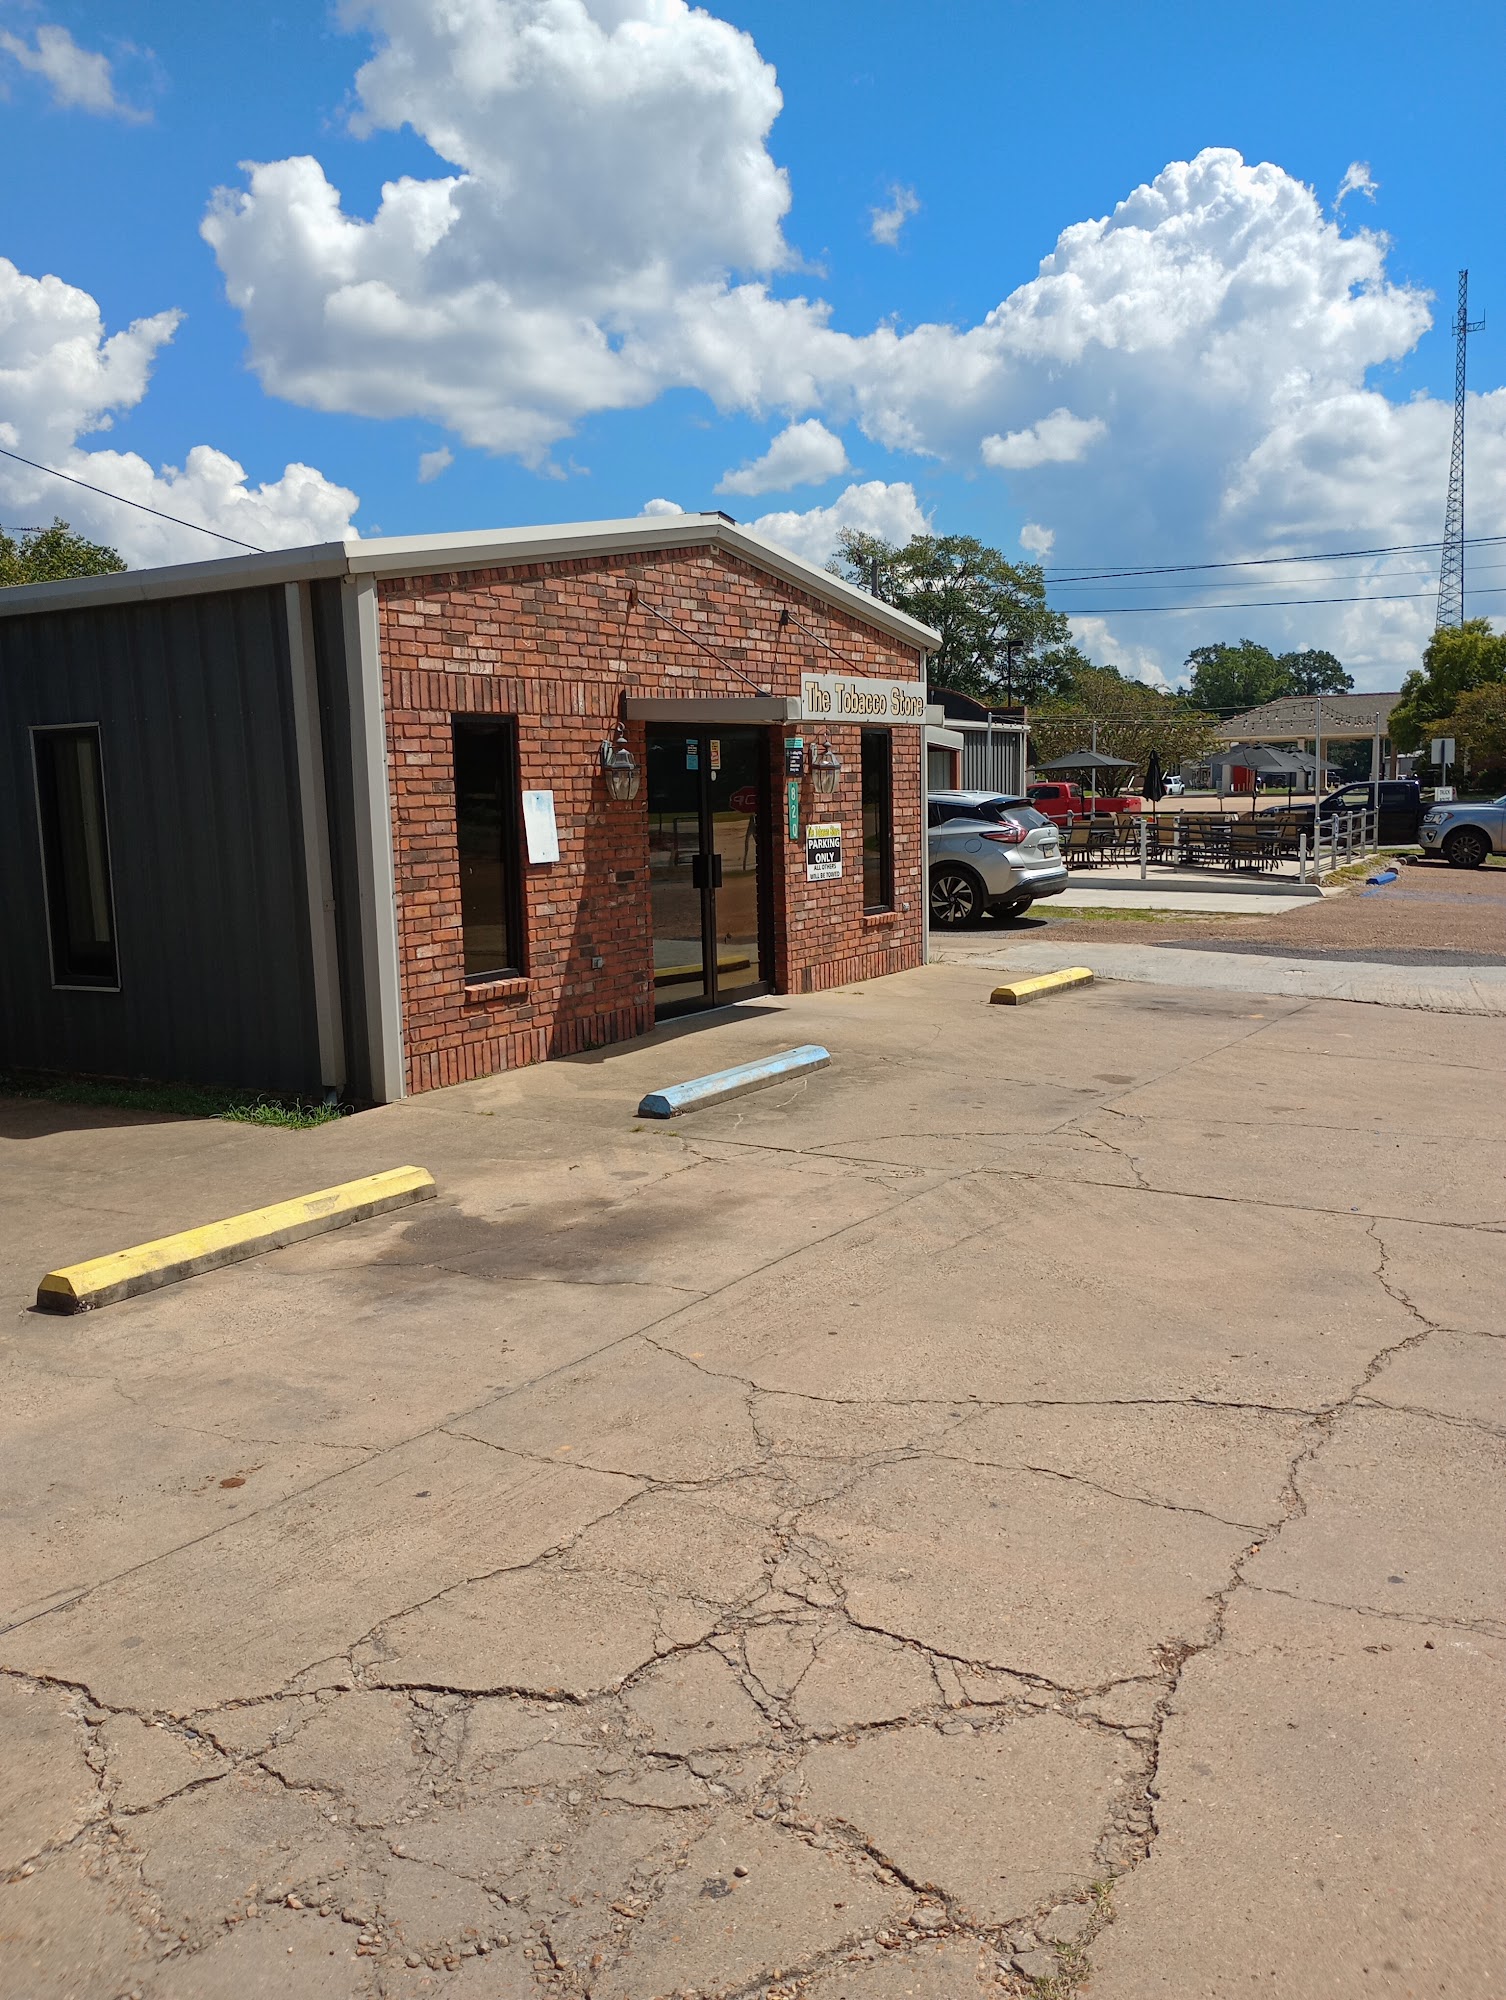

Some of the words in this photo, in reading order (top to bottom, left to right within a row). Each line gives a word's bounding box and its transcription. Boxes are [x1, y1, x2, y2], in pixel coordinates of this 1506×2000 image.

[805, 681, 831, 713] The
[835, 683, 887, 715] Tobacco
[890, 686, 924, 717] Store
[790, 787, 799, 839] 820
[808, 838, 840, 850] PARKING
[815, 852, 834, 863] ONLY
